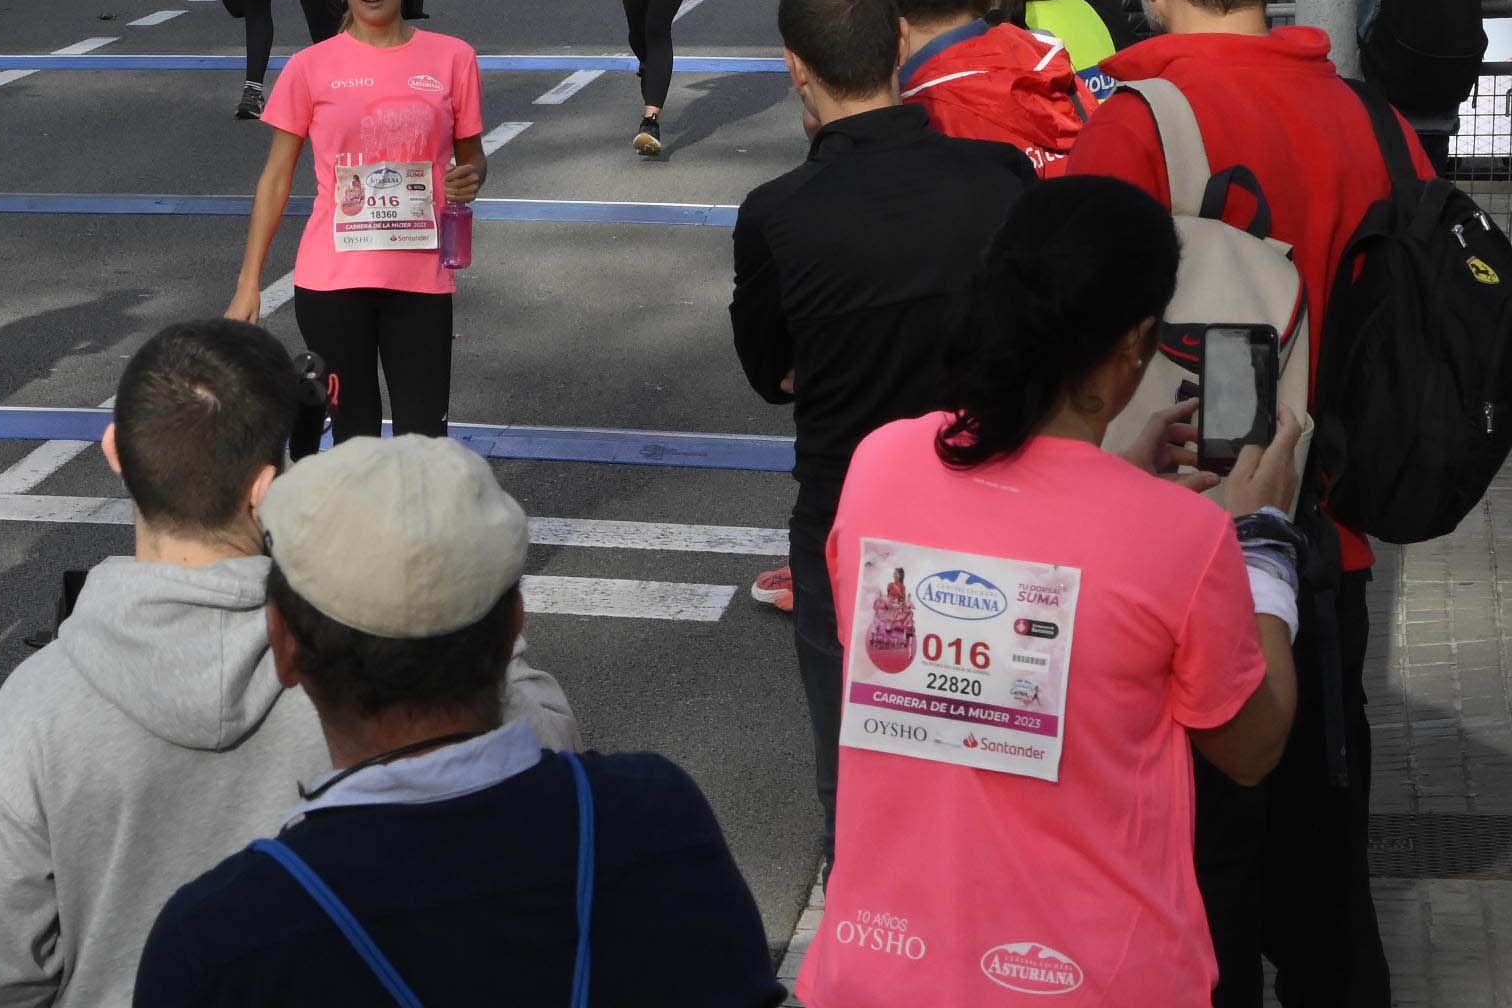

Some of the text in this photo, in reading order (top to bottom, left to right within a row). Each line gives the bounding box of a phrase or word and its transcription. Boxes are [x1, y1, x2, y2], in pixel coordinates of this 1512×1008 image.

[331, 77, 375, 89] OYSHO
[366, 195, 400, 208] 016
[370, 210, 398, 219] 18360
[397, 234, 430, 242] Santander
[922, 582, 1000, 613] ASTURIANA
[1017, 591, 1060, 608] SUMA
[922, 633, 991, 670] 016
[926, 672, 982, 697] 22820
[872, 691, 1041, 729] CARRERA DE LA MUJER 2023
[863, 718, 928, 742] OYSHO
[980, 737, 1046, 761] Santander
[856, 909, 908, 933] 10 AÑOS
[835, 920, 927, 961] OYSHO
[989, 955, 1076, 988] ASTURIANA
